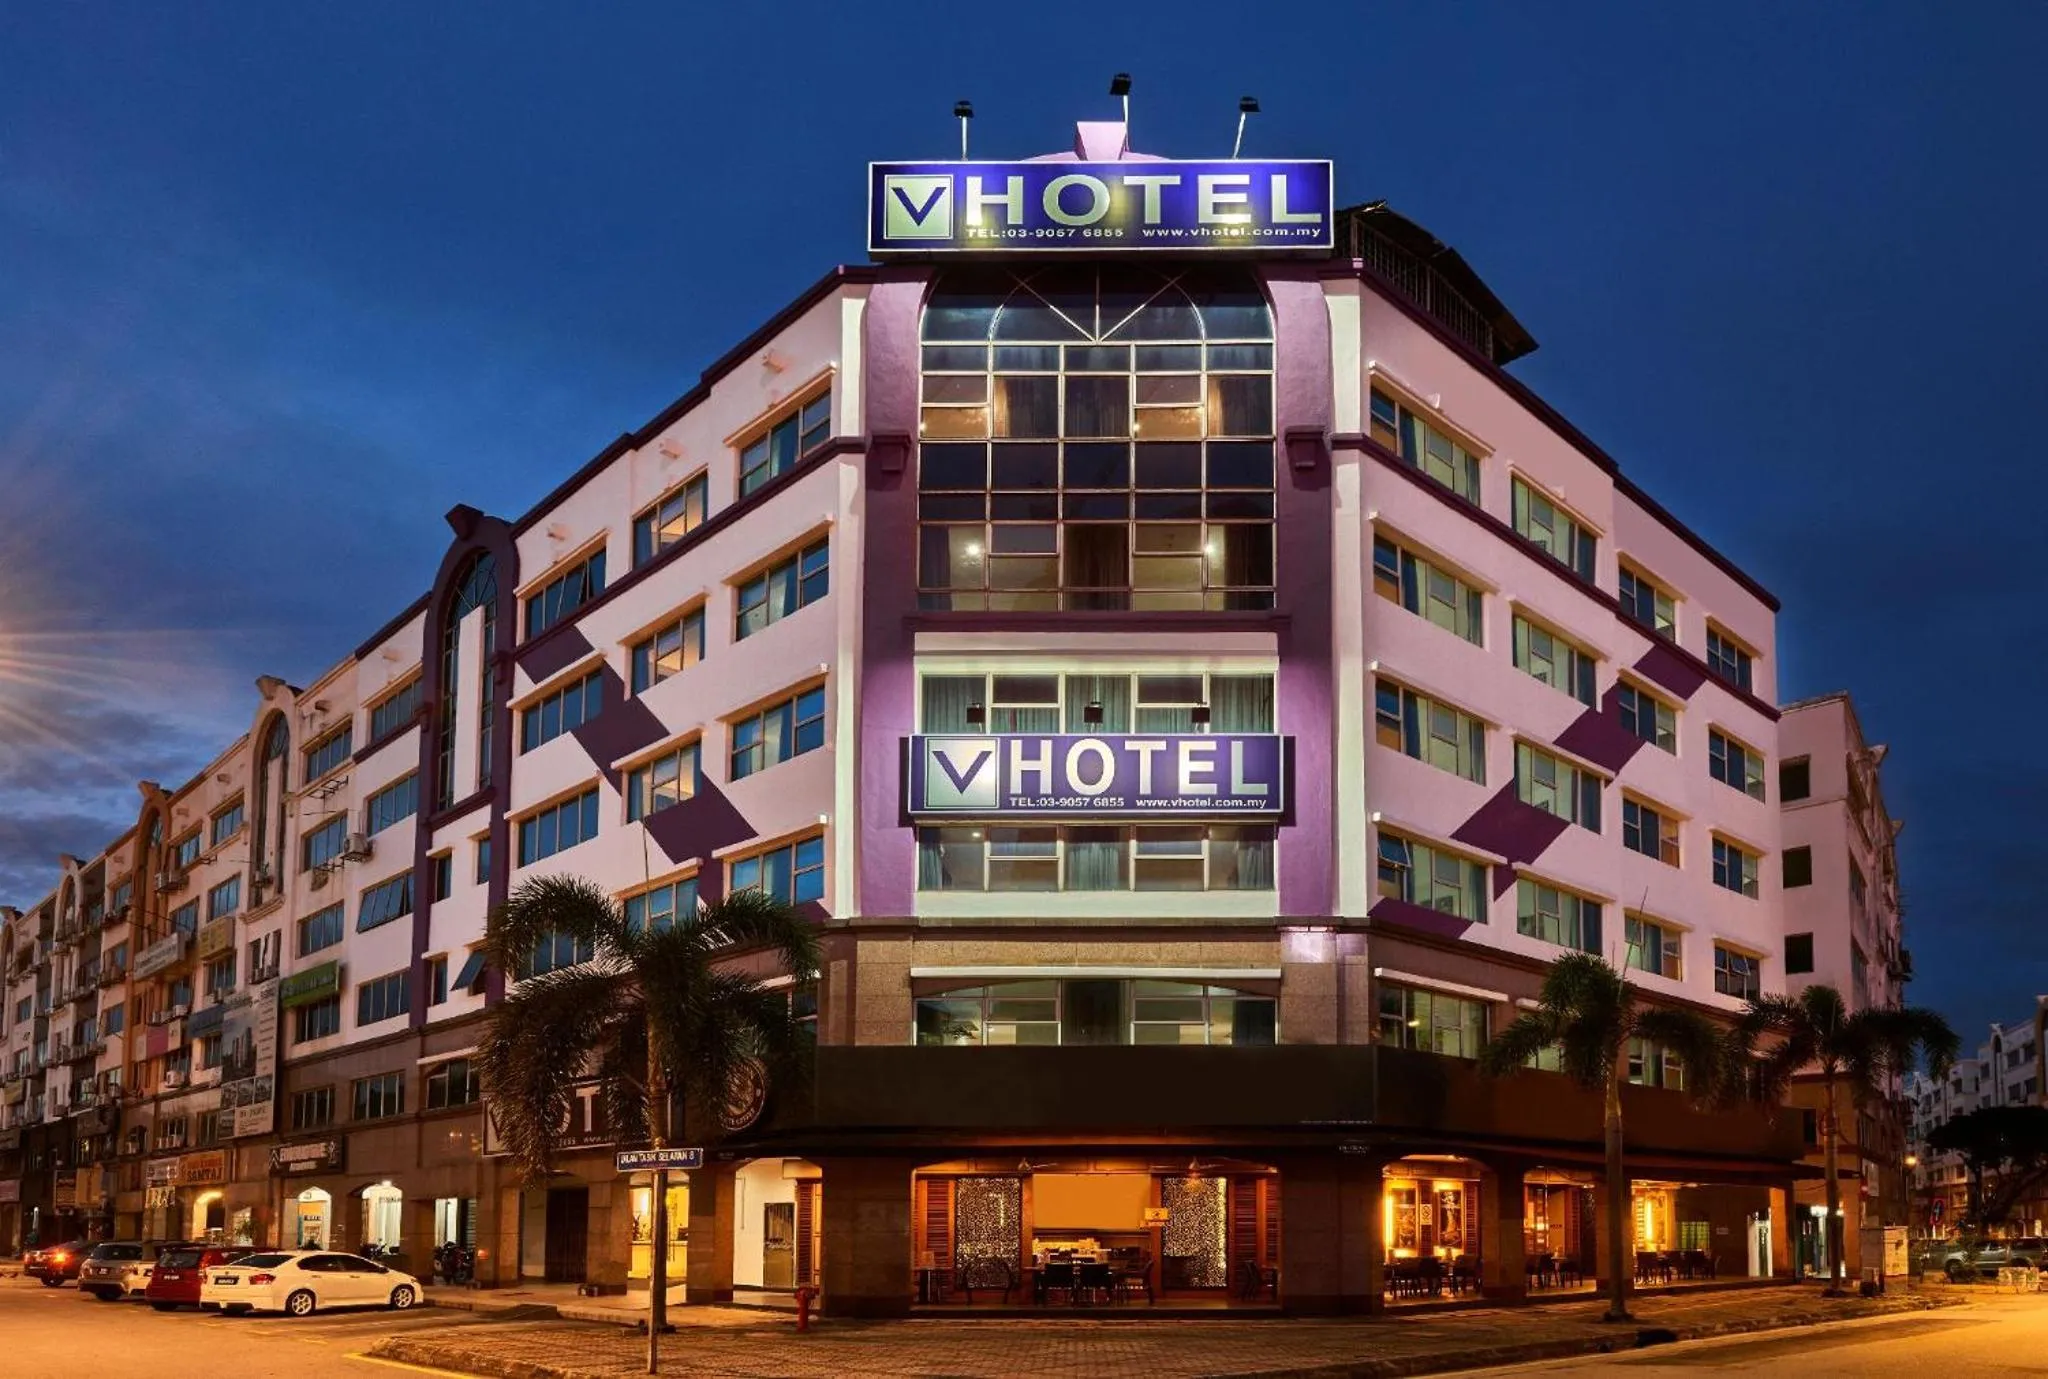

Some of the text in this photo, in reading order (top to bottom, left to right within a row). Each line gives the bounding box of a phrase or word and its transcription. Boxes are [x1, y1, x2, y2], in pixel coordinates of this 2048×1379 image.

[892, 174, 1322, 227] V HOTEL
[1142, 227, 1321, 238] www.vhotel.com.my
[932, 738, 1269, 795] V HOTEL
[1093, 797, 1125, 808] 6855
[1136, 797, 1267, 809] www.vhotel.com.my
